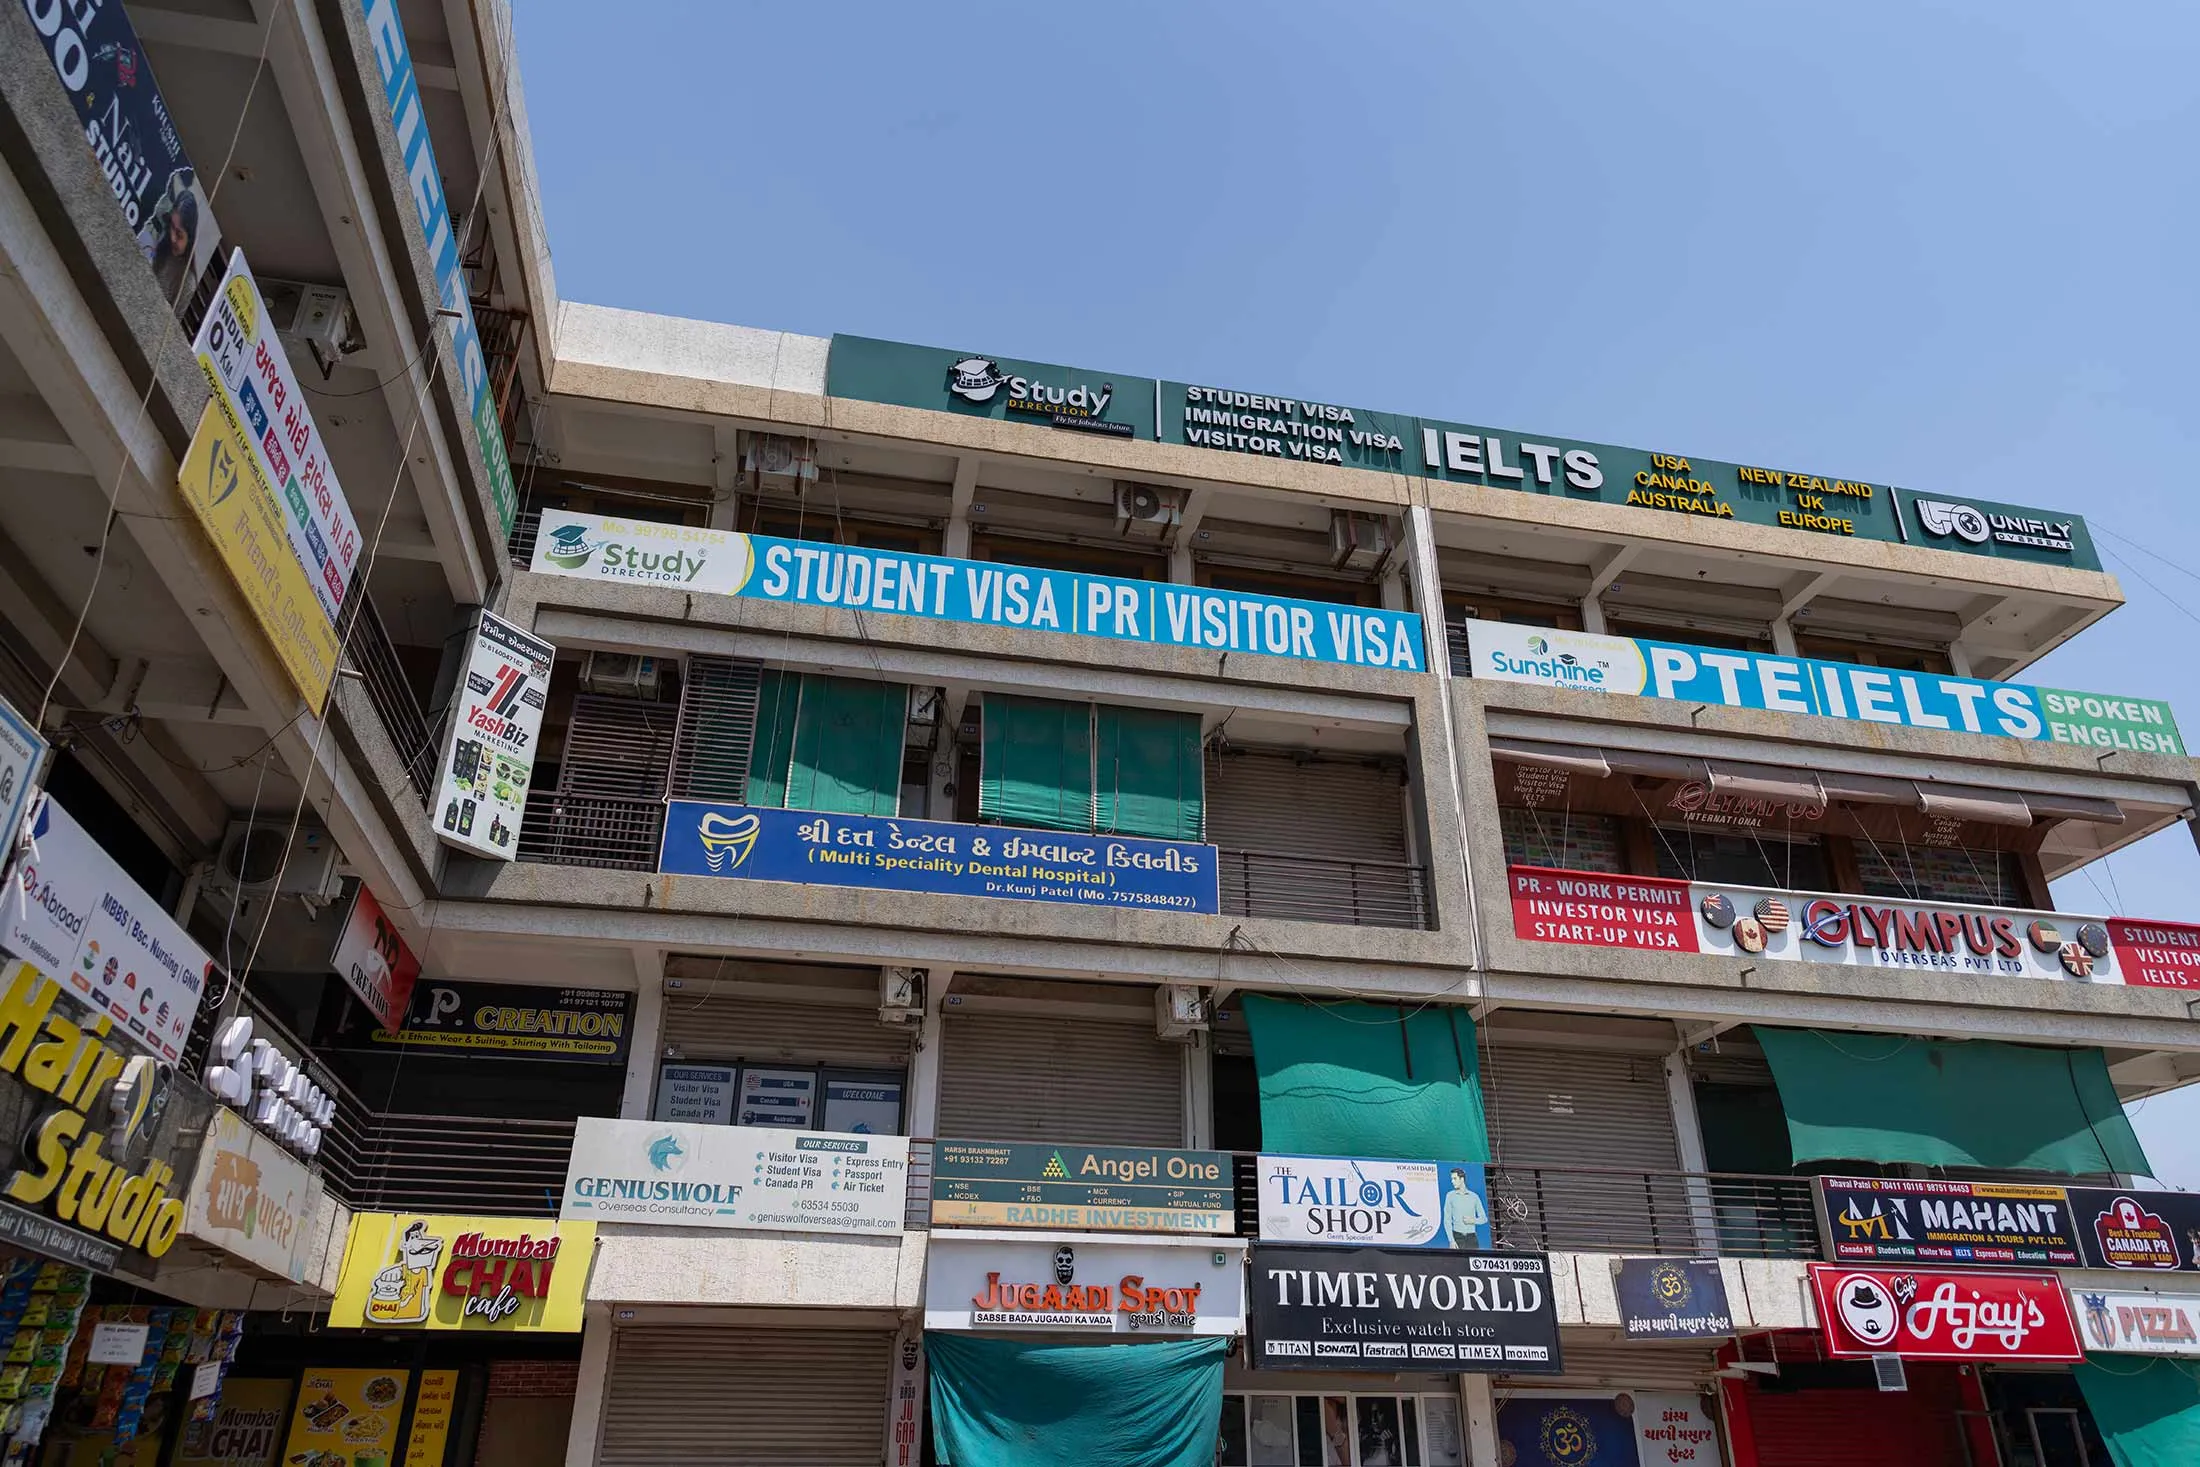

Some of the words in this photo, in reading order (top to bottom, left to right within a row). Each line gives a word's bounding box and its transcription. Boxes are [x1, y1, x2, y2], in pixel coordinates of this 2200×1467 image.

[102, 91, 152, 203] Nail
[86, 119, 139, 226] STUDIO
[397, 94, 483, 414] IELTS
[218, 300, 244, 355] INDIA
[1009, 378, 1111, 416] Study
[1009, 400, 1088, 417] DIRECTION
[1187, 386, 1295, 414] STUDENT
[1302, 402, 1355, 423] VISA
[1185, 407, 1343, 442] IMMIGRATION
[1349, 429, 1403, 450] VISA
[1186, 428, 1282, 454] VISITOR
[1288, 440, 1342, 462] VISA
[481, 397, 516, 520] SPOKEN
[1422, 428, 1604, 491] IELTS
[1652, 453, 1691, 472] USA
[1635, 471, 1716, 495] CANADA
[1739, 466, 1782, 485] NEW
[1786, 472, 1873, 498] ZEALAND
[1626, 489, 1734, 517] AUSTRALIA
[1798, 493, 1824, 511] UK
[1779, 511, 1854, 535] EUROPE
[1989, 513, 2071, 538] UNIFLY
[1997, 533, 2074, 549] OVERSEAS
[601, 566, 681, 582] DIRECTION
[603, 543, 707, 582] Study
[233, 509, 281, 602] Friend's
[283, 595, 327, 687] Collection
[762, 546, 954, 616] STUDENT
[966, 567, 1060, 627] VISA
[1088, 582, 1140, 637] PR
[1166, 593, 1314, 658] VISITOR
[1327, 613, 1418, 670] VISA
[1491, 651, 1604, 683] Sunshine
[1650, 647, 1808, 714] PTE
[1821, 667, 2041, 739] IELTS
[2047, 693, 2163, 724] SPOKEN
[467, 705, 530, 748] YashBiz
[2050, 721, 2178, 756] ENGLISH
[474, 729, 519, 754] MARKETING
[1517, 772, 1548, 782] Student
[1551, 775, 1568, 783] Visa
[1519, 779, 1546, 789] Visitor
[1513, 785, 1534, 794] Work
[1536, 787, 1561, 797] Permit
[1683, 812, 1762, 828] INTERNATIONAL
[797, 819, 830, 844] શ્રી
[888, 823, 956, 853] ડેન્ટલ
[971, 838, 991, 857] &
[1518, 877, 1541, 894] PR
[1557, 880, 1612, 899] WORK
[1617, 885, 1682, 905] PERMIT
[1530, 900, 1628, 922] INVESTOR
[1632, 908, 1678, 926] VISA
[1535, 922, 1628, 944] START-UP
[1634, 930, 1680, 948] VISA
[1801, 900, 2021, 959] OLYMPUS
[2124, 927, 2199, 947] STUDENT
[102, 891, 129, 928] MBBS
[151, 938, 180, 981] Nursing
[183, 965, 200, 995] GNM
[1881, 951, 1957, 968] OVERSEAS
[1964, 957, 1990, 970] PVT
[1998, 960, 2023, 973] LTD
[2142, 969, 2188, 985] IELTS
[351, 962, 391, 1018] CREATION
[474, 1006, 624, 1038] CREATION
[0, 961, 125, 1114] Hair
[768, 1152, 798, 1163] Visitor
[799, 1154, 818, 1164] Visa
[803, 1141, 822, 1149] OUR
[822, 1142, 861, 1151] SERVICES
[767, 1165, 800, 1176] Student
[802, 1167, 822, 1177] Visa
[845, 1169, 882, 1182] Passport
[846, 1156, 879, 1168] Express
[882, 1159, 904, 1171] Entry
[1080, 1153, 1158, 1182] Angel
[1166, 1157, 1221, 1181] One
[1274, 1166, 1293, 1176] THE
[8, 1109, 185, 1259] Studio
[574, 1177, 743, 1205] GENIUSWOLF
[765, 1178, 798, 1189] Canada
[800, 1180, 813, 1190] PR
[843, 1182, 857, 1192] Air
[859, 1182, 885, 1193] Ticket
[954, 1183, 970, 1191] NSE
[1269, 1175, 1422, 1217] TAILOR
[598, 1201, 648, 1214] Overseas
[649, 1203, 714, 1217] Consultancy
[801, 1200, 829, 1211] 63534
[831, 1201, 859, 1213] 55030
[954, 1193, 979, 1201] NCDEX
[1093, 1197, 1132, 1207] CURRENCY
[1172, 1200, 1201, 1209] MUTUAL
[1202, 1201, 1222, 1210] FUND
[1007, 1206, 1079, 1226] RADHE
[1086, 1208, 1221, 1229] INVESTMENT
[1306, 1207, 1392, 1235] SHOP
[1920, 1200, 2058, 1234] MAHANT
[452, 1233, 561, 1260] Mumbai
[1927, 1232, 1985, 1242] IMMIGRATION
[1986, 1234, 1994, 1242] &
[1995, 1235, 2024, 1244] TOURS
[2028, 1236, 2047, 1245] PVT.
[2048, 1237, 2066, 1245] LTD.
[2107, 1238, 2151, 1252] CANADA
[2154, 1239, 2170, 1253] PR
[1483, 1260, 1510, 1270] 70431
[1513, 1261, 1540, 1271] 99993
[1975, 1250, 1997, 1260] Express
[442, 1259, 555, 1297] CHAI
[973, 1272, 1113, 1312] JUGAADI
[1118, 1275, 1201, 1313] SPOT
[1269, 1269, 1380, 1308] TIME
[1385, 1273, 1542, 1313] WORLD
[465, 1286, 519, 1323] cafe
[1906, 1282, 2044, 1350] Ajay's
[977, 1313, 1007, 1323] SABSE
[1008, 1313, 1034, 1323] BADA
[1036, 1314, 1073, 1323] JUGAADI
[1075, 1315, 1088, 1324] KA
[1089, 1316, 1112, 1325] VADA
[1130, 1310, 1165, 1328] જુગાડી
[1169, 1311, 1196, 1326] સ્પોટ
[1322, 1318, 1401, 1336] Exclusive
[1406, 1321, 1451, 1336] watch
[1457, 1325, 1495, 1337] store
[2116, 1306, 2197, 1341] PIZZA
[1278, 1342, 1309, 1354] TITAN
[1317, 1344, 1357, 1354] SONATA
[1365, 1344, 1406, 1357] fastrack
[1413, 1346, 1453, 1357] LAMEX
[1460, 1346, 1500, 1358] TIMEX
[1507, 1348, 1546, 1360] maxima
[219, 1408, 281, 1428] Mumbai
[210, 1428, 273, 1460] CHAI
